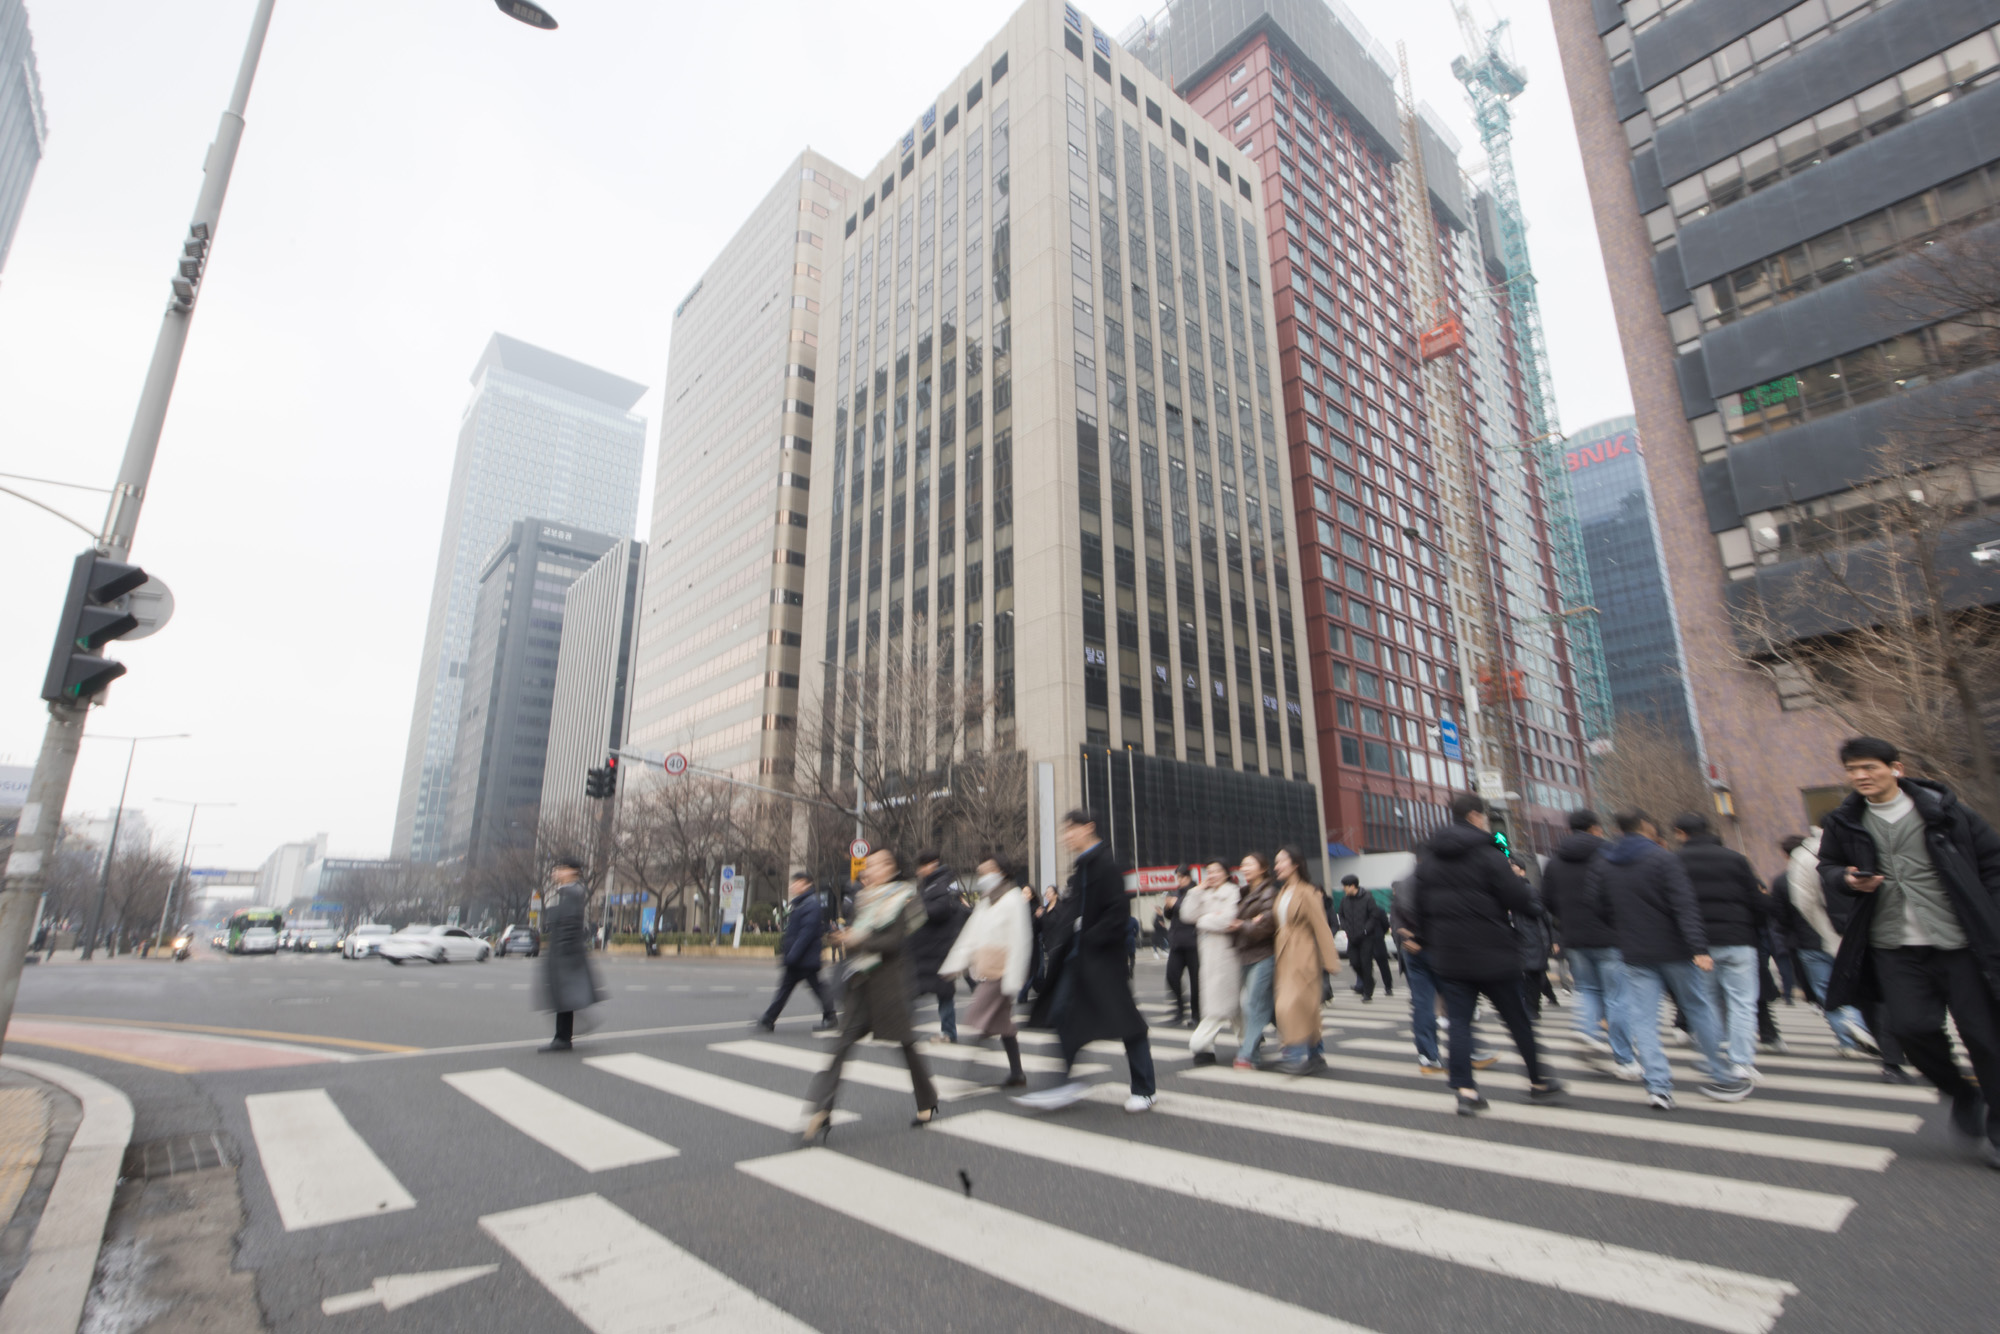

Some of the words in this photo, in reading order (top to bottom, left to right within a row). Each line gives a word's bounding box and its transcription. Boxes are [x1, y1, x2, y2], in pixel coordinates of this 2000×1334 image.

[1565, 434, 1631, 472] BNK
[543, 526, 572, 541] 교보증권
[1085, 646, 1106, 665] 탈모
[669, 758, 683, 769] 40
[854, 844, 867, 855] 30
